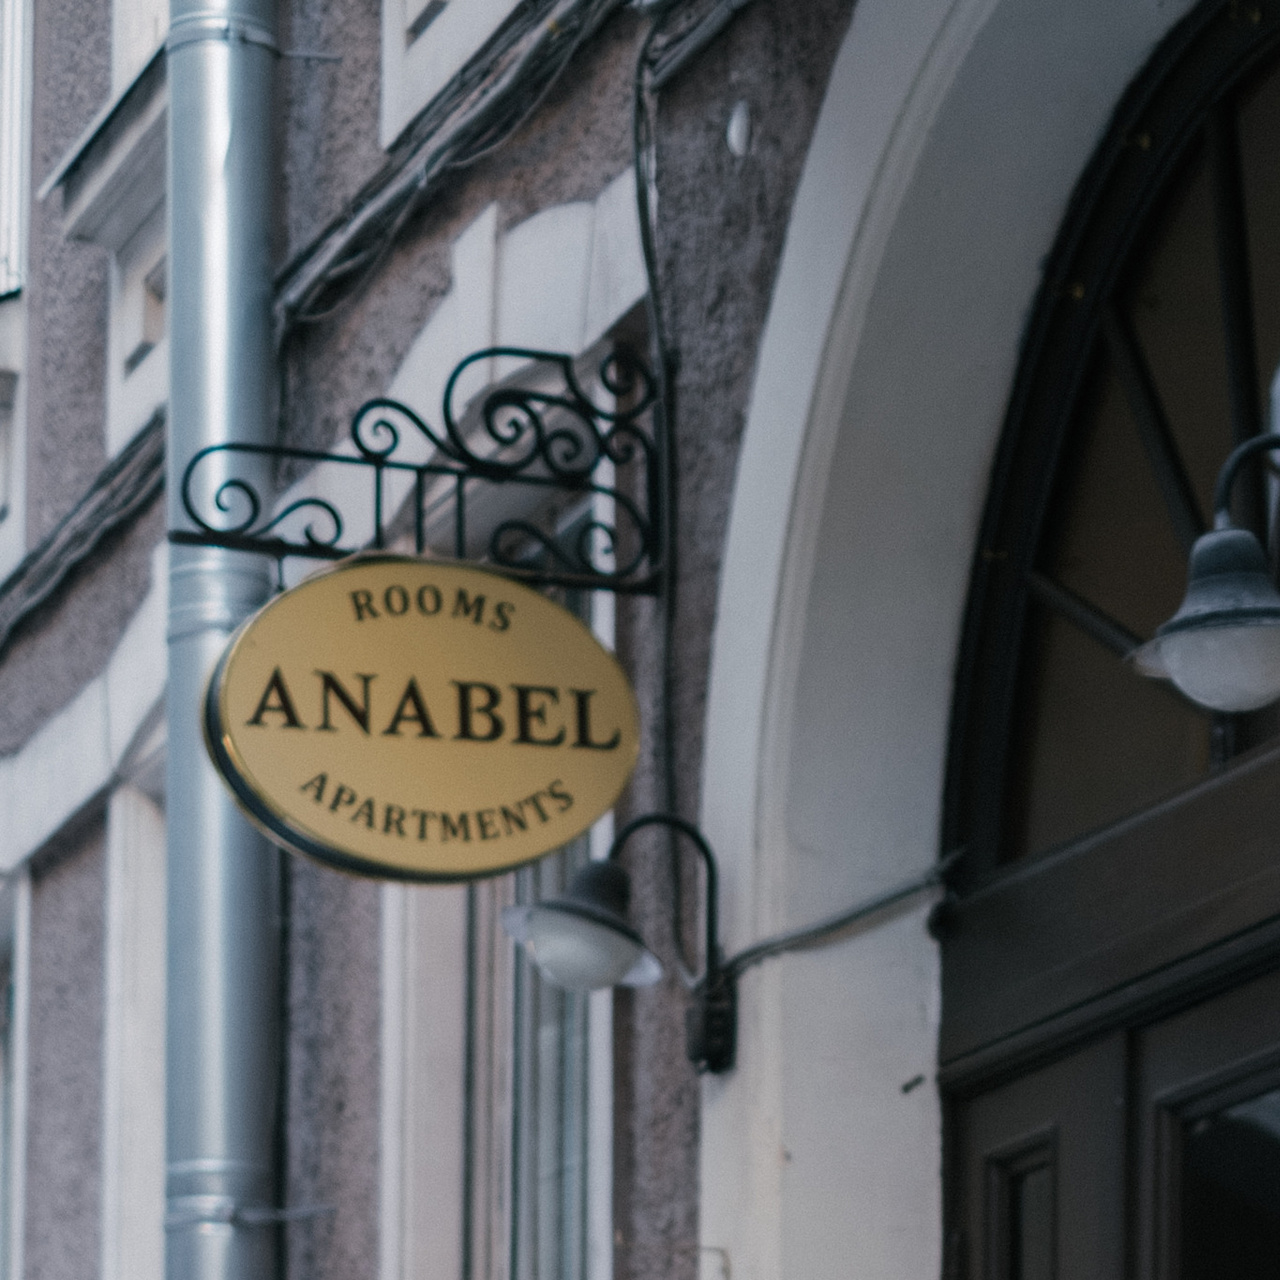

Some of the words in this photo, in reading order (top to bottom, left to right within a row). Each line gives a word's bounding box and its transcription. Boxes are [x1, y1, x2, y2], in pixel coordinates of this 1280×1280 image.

[350, 584, 515, 632] ROOMS
[246, 665, 622, 751] ANABEL
[301, 772, 574, 843] APARTMENTS
